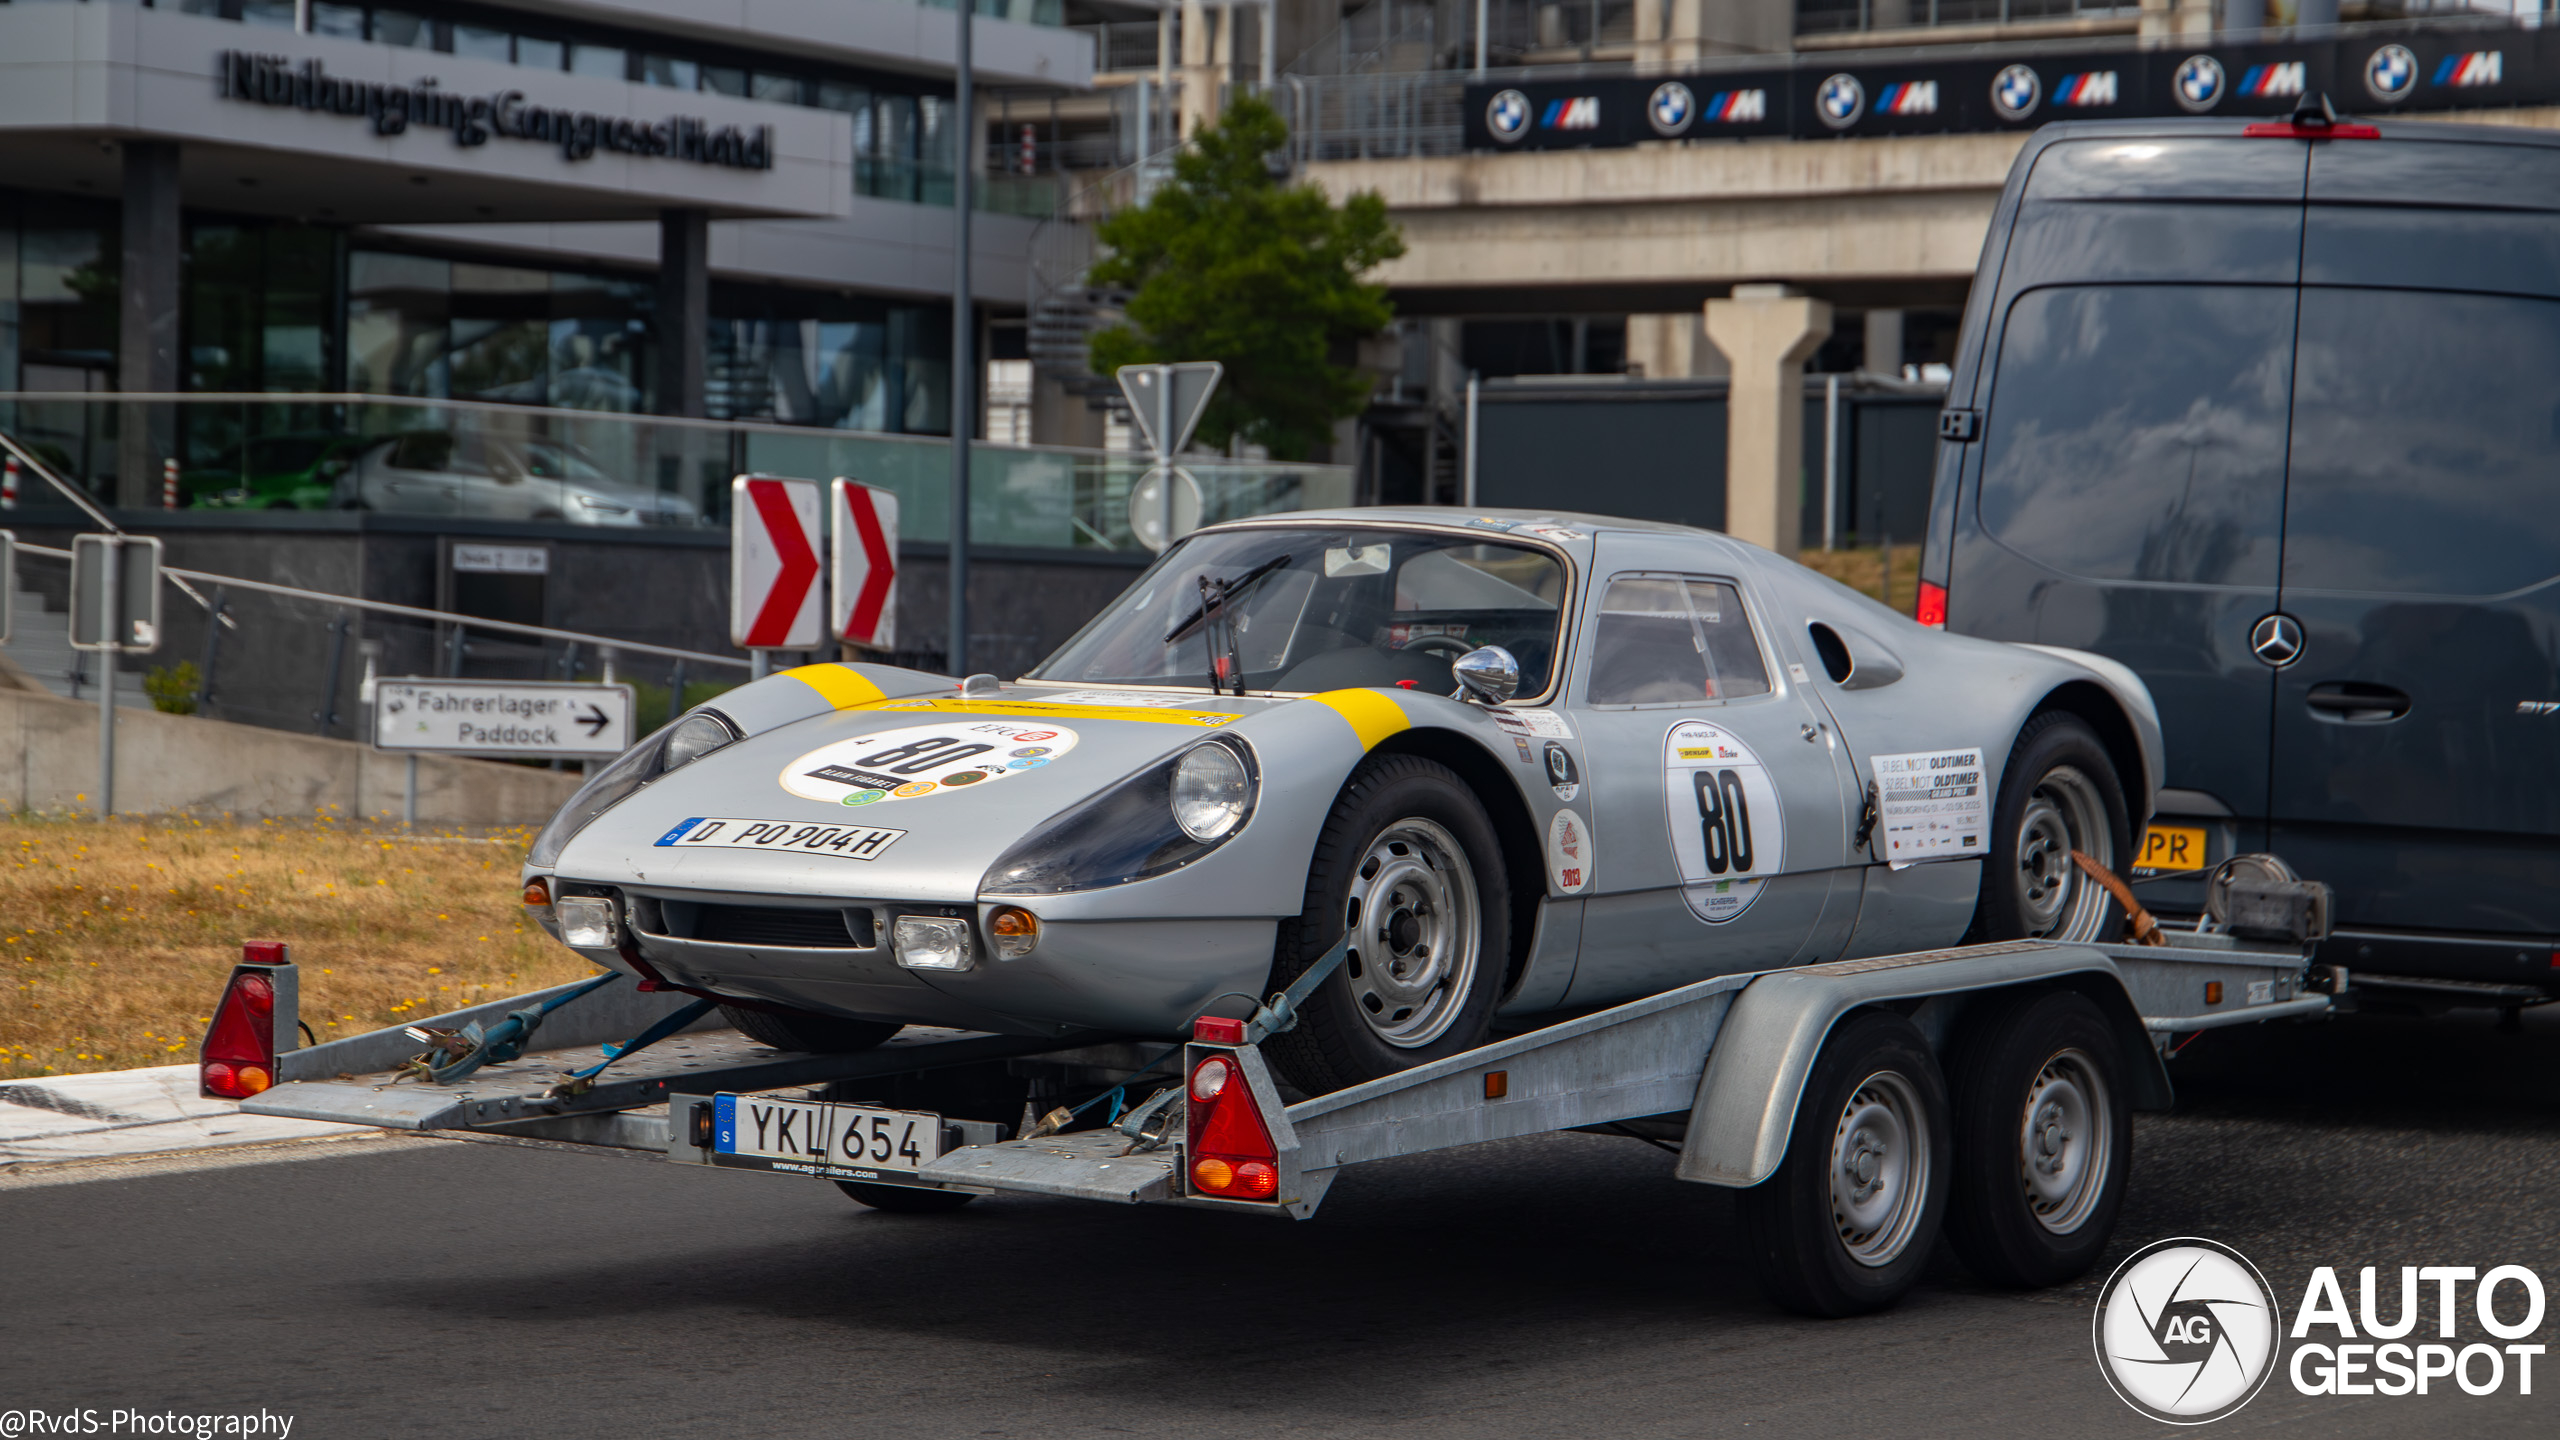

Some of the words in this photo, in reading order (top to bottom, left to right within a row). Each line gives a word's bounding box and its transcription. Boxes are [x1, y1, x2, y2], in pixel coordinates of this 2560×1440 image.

[217, 50, 488, 148] Nürburgring
[417, 690, 558, 718] Fahrerlager
[458, 722, 558, 744] Paddock
[854, 736, 995, 775] 80
[1930, 754, 1976, 770] OLDTIMER
[1934, 772, 1979, 787] OLDTIMER
[1931, 788, 1952, 798] GRAND
[1953, 787, 1968, 797] PRIX
[686, 821, 727, 842] D
[1693, 769, 1754, 875] 80
[1562, 867, 1581, 887] 2013
[721, 1130, 731, 1143] S
[750, 1104, 826, 1156] YKL
[841, 1114, 921, 1167] 654
